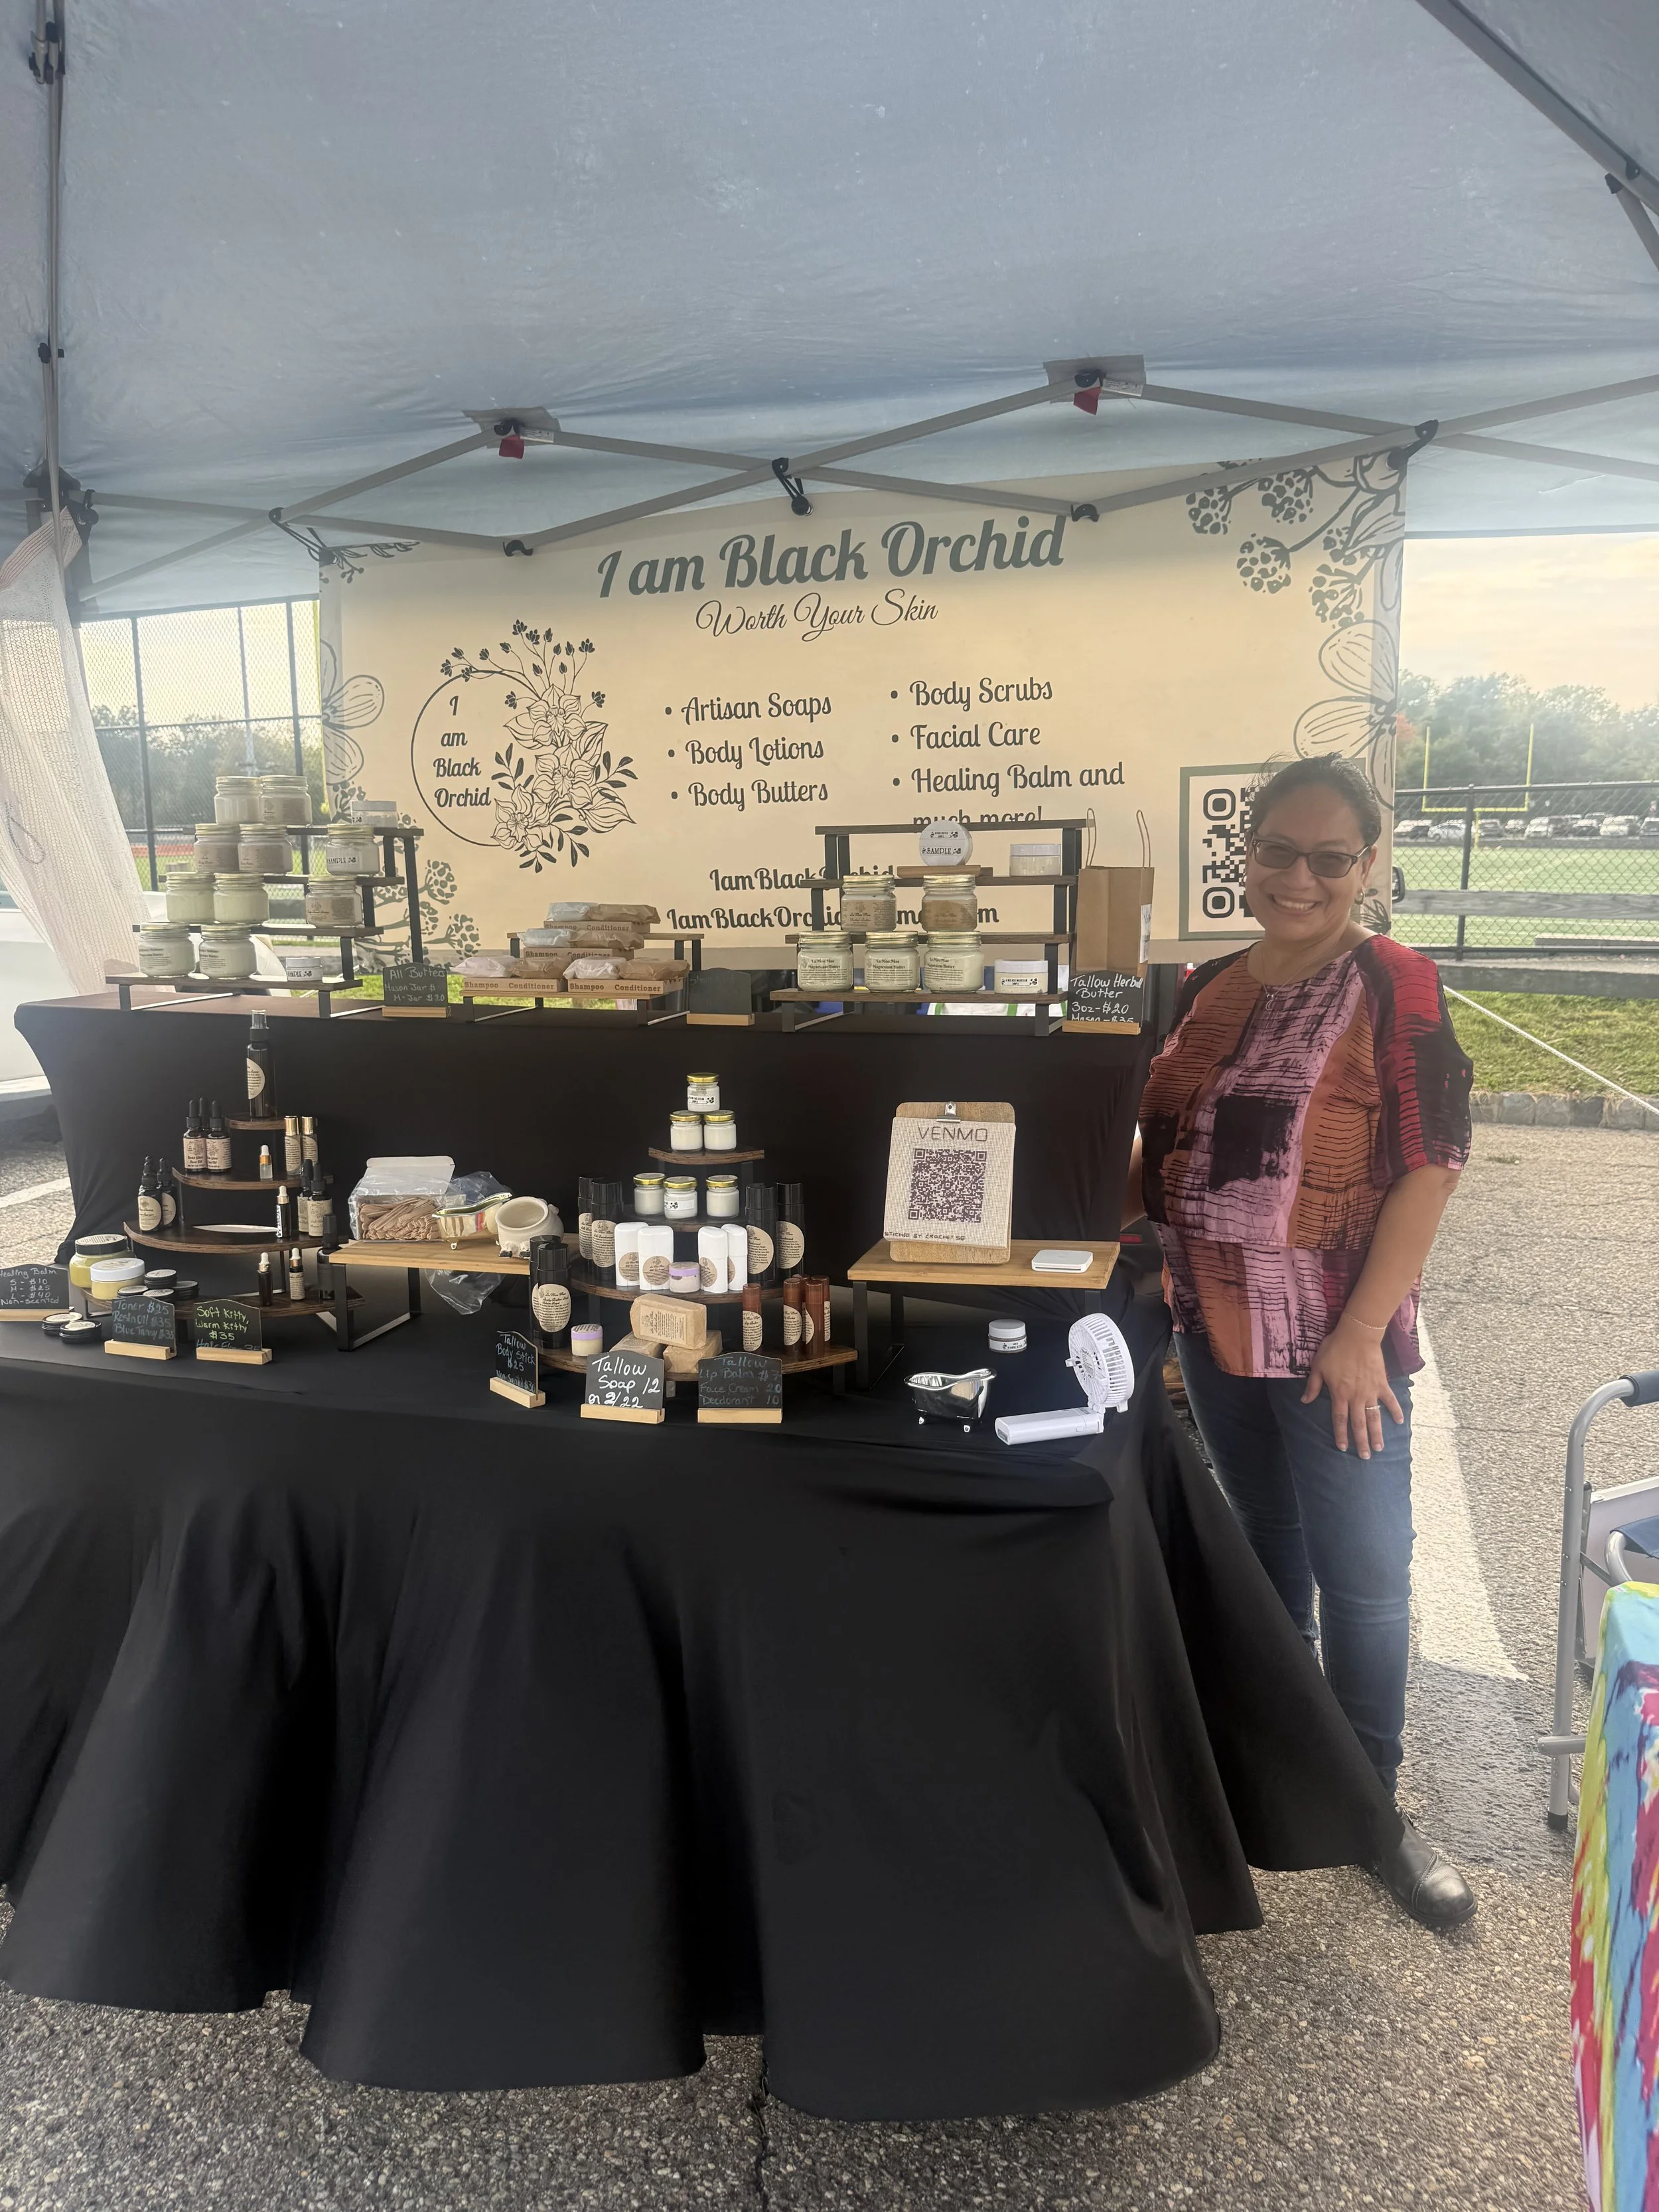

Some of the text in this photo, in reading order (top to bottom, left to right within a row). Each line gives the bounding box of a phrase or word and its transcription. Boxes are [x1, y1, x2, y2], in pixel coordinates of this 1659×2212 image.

[597, 515, 1066, 597] I am Black Orchid
[695, 588, 939, 642] Worth Your Skin
[909, 677, 1053, 712] Body Scrubs
[449, 696, 459, 716] I
[681, 692, 831, 725] Artisan Soaps
[441, 732, 469, 747] am
[910, 721, 1041, 749] Facial Care
[685, 737, 824, 770] Body Lotions
[433, 757, 482, 778] Black
[911, 761, 1125, 797] Healing Balm and
[434, 787, 492, 808] Orchid
[688, 779, 829, 812] Body Butters
[390, 969, 403, 980] All
[1070, 974, 1110, 988] Tallow
[465, 981, 555, 990] Shampoo Conditioner
[569, 983, 605, 992] Shampoo
[1076, 987, 1123, 999] Butter
[918, 1126, 988, 1142] VENMO
[114, 1299, 169, 1315] Toner $25
[196, 1306, 220, 1317] Soft
[113, 1323, 136, 1335] Blue
[195, 1318, 220, 1329] Warm
[209, 1329, 235, 1340] $35
[500, 1334, 526, 1350] Tallow
[496, 1343, 536, 1365] Body Stick
[591, 1355, 647, 1376] Tallow
[713, 1357, 767, 1368] Tallow
[699, 1368, 717, 1381] Lip
[719, 1367, 755, 1378] Balm
[598, 1374, 636, 1394] Soap
[699, 1381, 781, 1394] Face Cream 20
[699, 1394, 780, 1406] Deodorant 10
